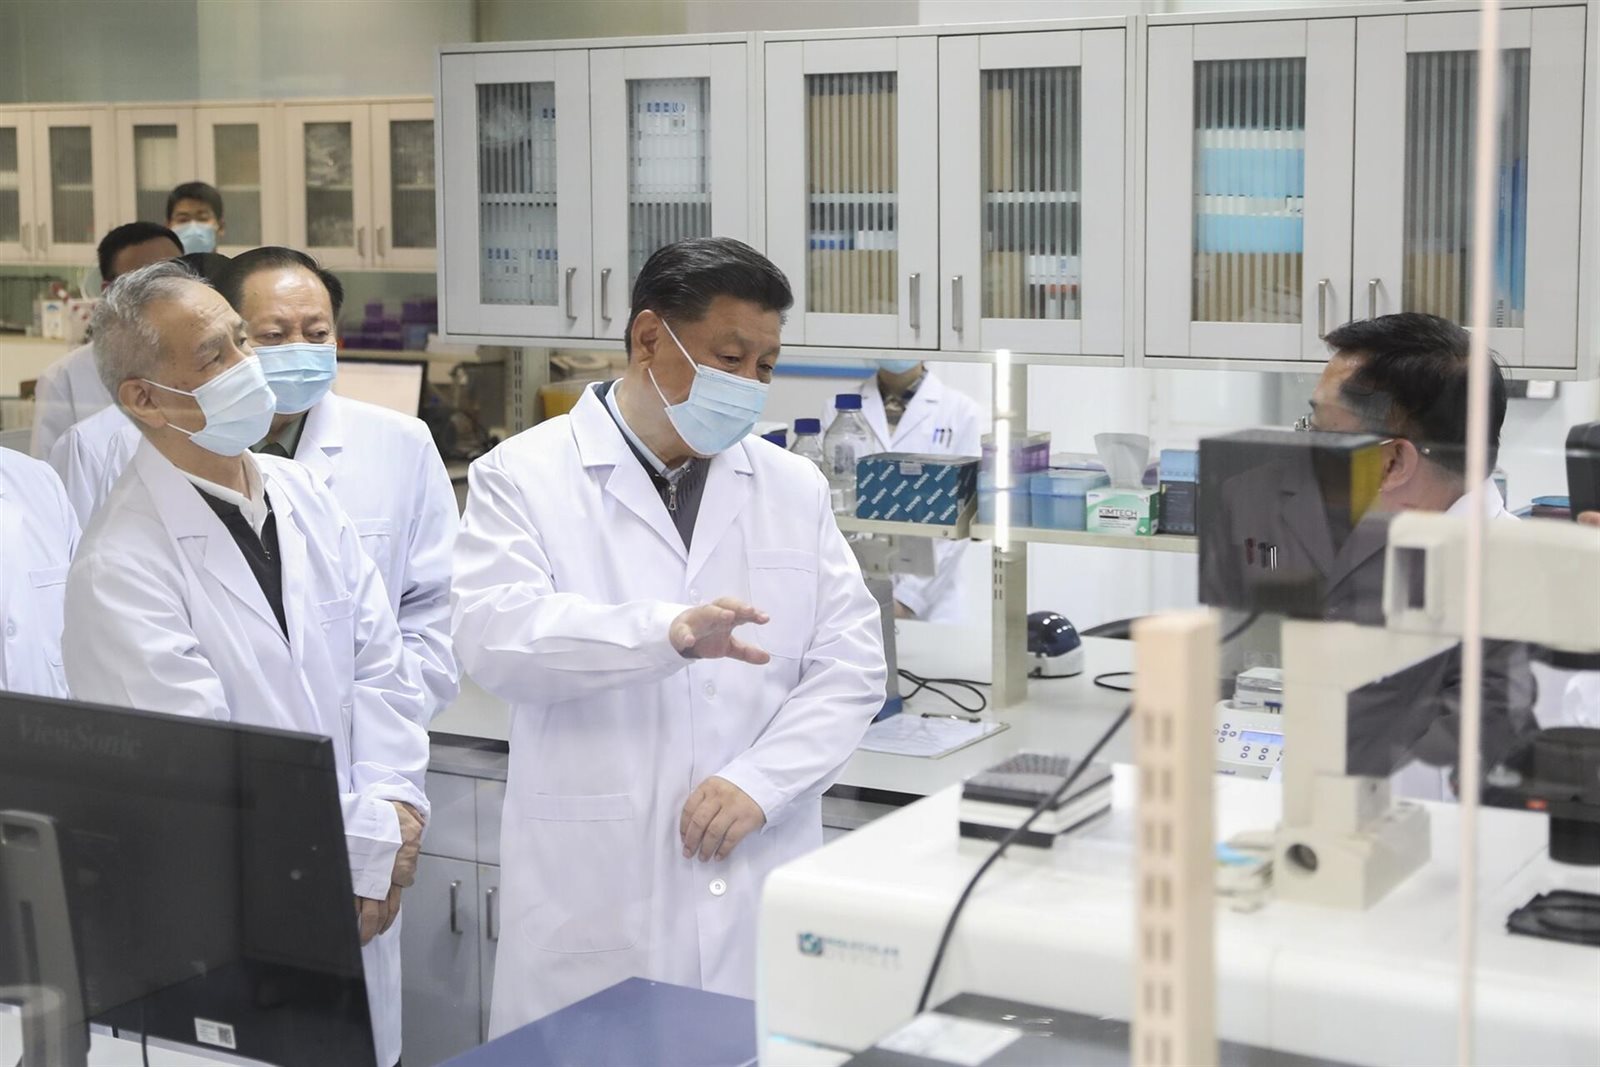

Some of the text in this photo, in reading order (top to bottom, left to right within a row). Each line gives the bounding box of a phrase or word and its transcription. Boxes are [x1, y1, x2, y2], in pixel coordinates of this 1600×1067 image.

[859, 472, 874, 488] QIAGEN
[879, 464, 894, 480] QIAGEN
[935, 464, 951, 481] QIAGEN
[892, 480, 907, 496] QIAGEN
[913, 472, 929, 489] QIAGEN
[871, 487, 886, 503] QIAGEN
[926, 488, 942, 505] QIAGEN
[884, 503, 899, 519] QIAGEN
[905, 495, 921, 512] QIAGEN
[939, 504, 956, 520] QIAGEN
[1099, 508, 1137, 517] KIMTECH
